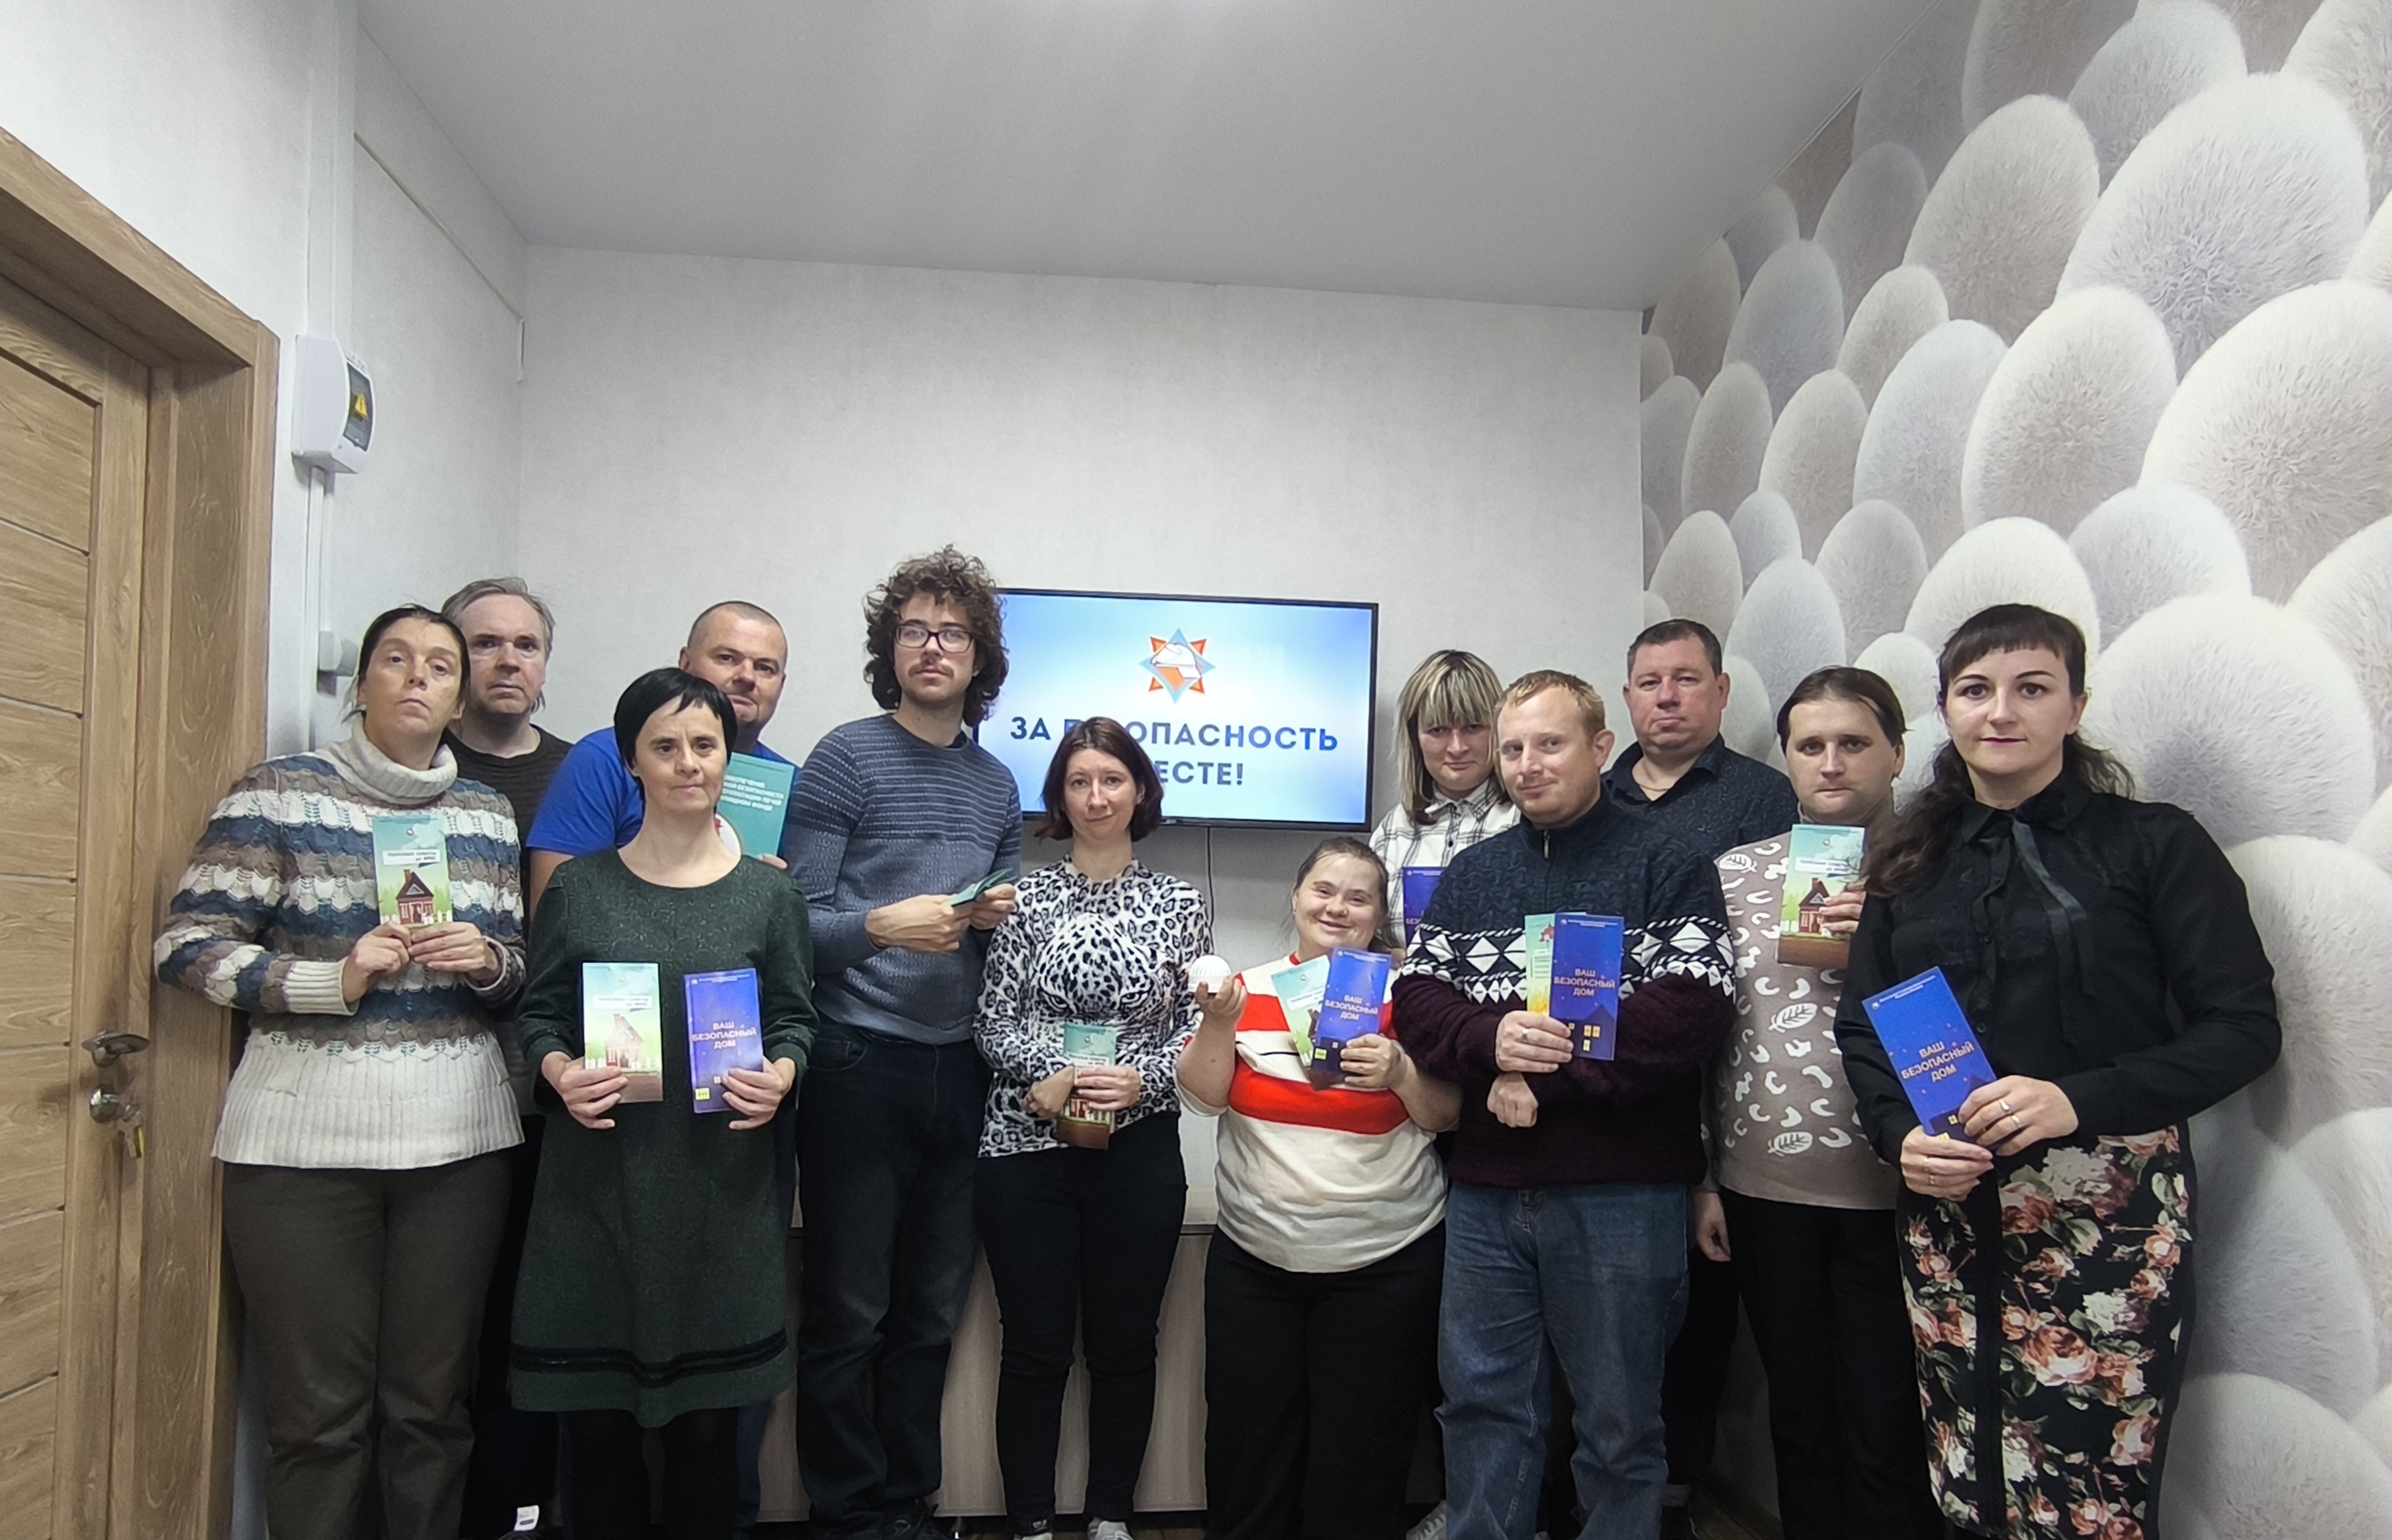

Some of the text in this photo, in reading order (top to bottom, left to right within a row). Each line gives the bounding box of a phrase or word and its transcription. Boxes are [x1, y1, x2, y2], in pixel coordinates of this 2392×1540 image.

[1010, 717, 1337, 750] ЗА ОПАСНОСТЬ
[1154, 760, 1244, 786] ЕСТЕ!
[1575, 969, 1595, 977] ВАШ
[1554, 977, 1614, 988] БЕЗОПАСНЫЙ
[1573, 988, 1594, 996] ДОМ
[1344, 995, 1362, 1004] ВАШ
[1325, 1000, 1378, 1015] БЕЗОПАСНЫЙ
[1340, 1012, 1359, 1020] ДОМ
[713, 1021, 734, 1030] ВАШ
[693, 1027, 756, 1041] БЕЗОПАСНЫЙ
[715, 1040, 736, 1049] ДОМ
[1918, 1040, 1946, 1058] ВАШ
[1900, 1040, 1975, 1079] БЕЗОПАСНЫЙ
[1930, 1064, 1957, 1083] ДОМ
